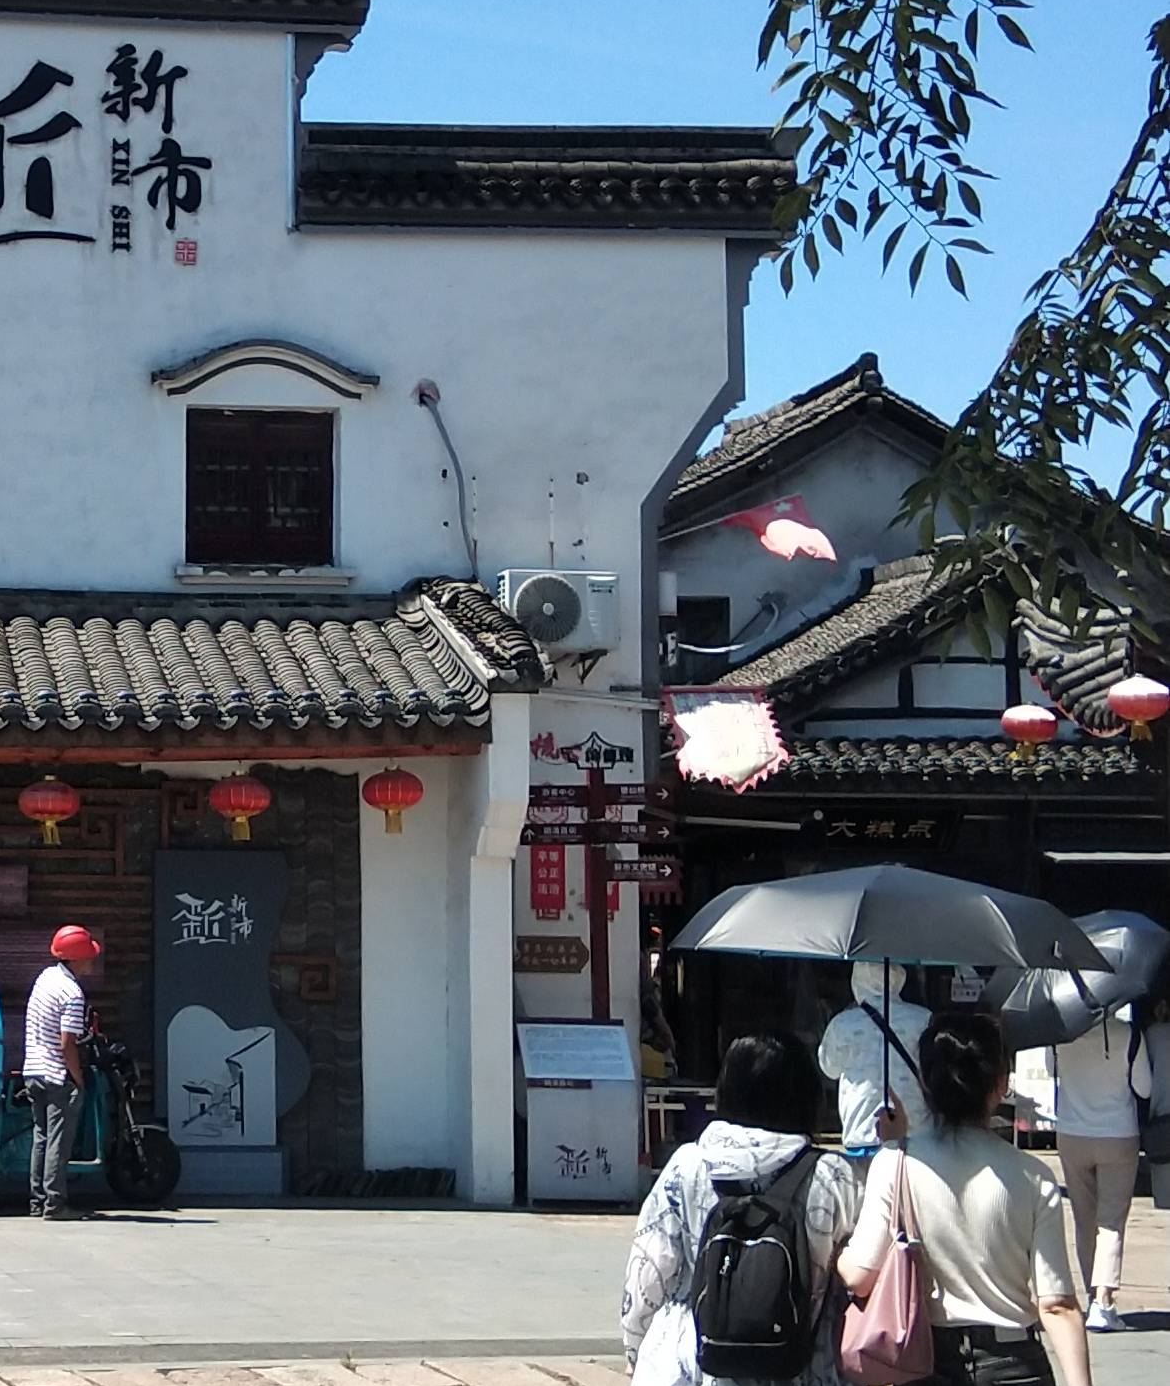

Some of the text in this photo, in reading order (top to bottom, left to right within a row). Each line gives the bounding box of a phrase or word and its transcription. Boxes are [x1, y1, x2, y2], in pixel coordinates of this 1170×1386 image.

[101, 44, 212, 230] 新市
[111, 138, 130, 252] XIN SHI
